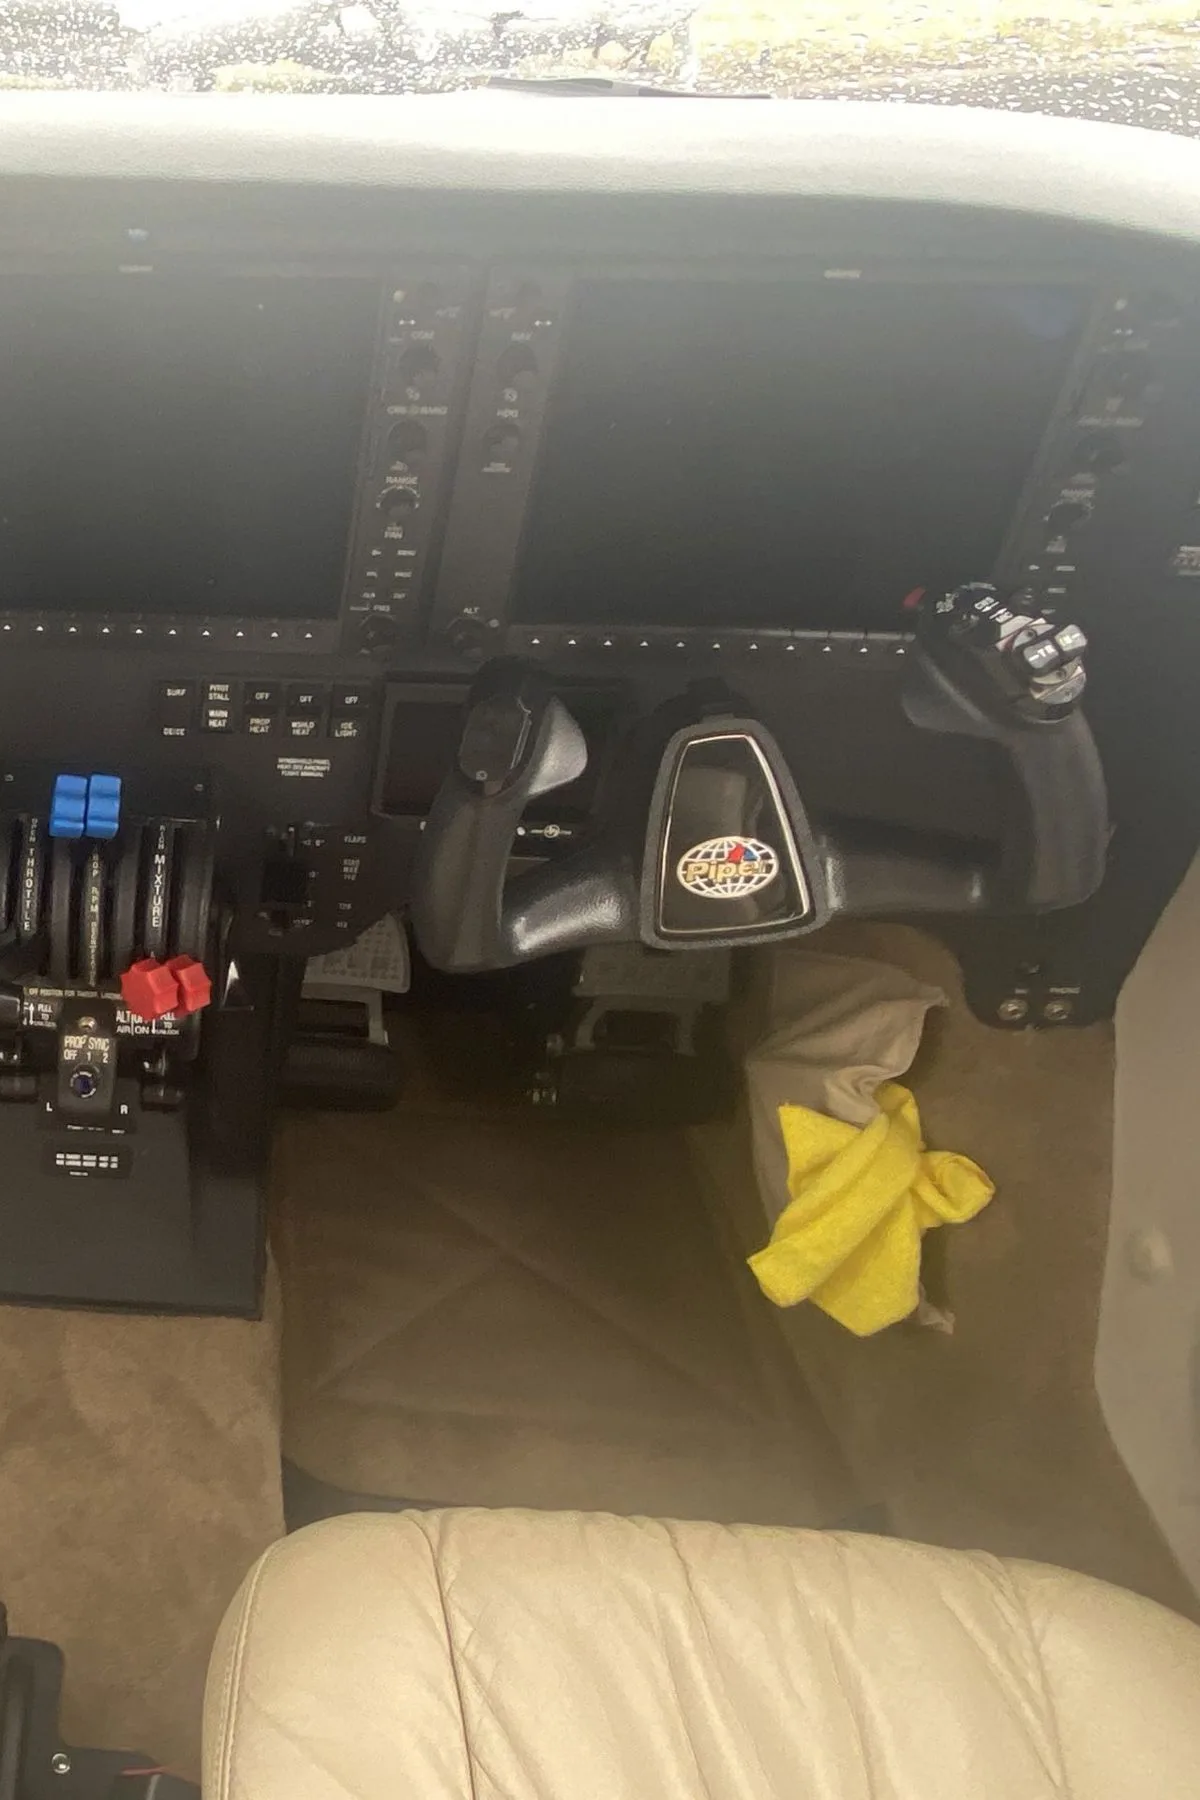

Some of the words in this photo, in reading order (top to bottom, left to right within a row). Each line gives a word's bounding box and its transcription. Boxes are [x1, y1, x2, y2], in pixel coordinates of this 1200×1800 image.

[255, 692, 270, 700] OFF
[345, 696, 358, 704] OFF
[686, 860, 767, 884] Piper
[23, 848, 35, 931] THROTTLE
[152, 854, 165, 927] MIXTURE
[116, 1010, 131, 1023] ALT
[117, 1025, 131, 1033] AIR
[135, 1026, 149, 1034] ON
[64, 1035, 87, 1048] PROP
[88, 1038, 110, 1051] SYNC
[64, 1050, 78, 1060] OFF
[86, 1051, 91, 1061] 1
[102, 1054, 108, 1063] 2
[46, 1102, 53, 1112] L
[120, 1104, 128, 1114] R
